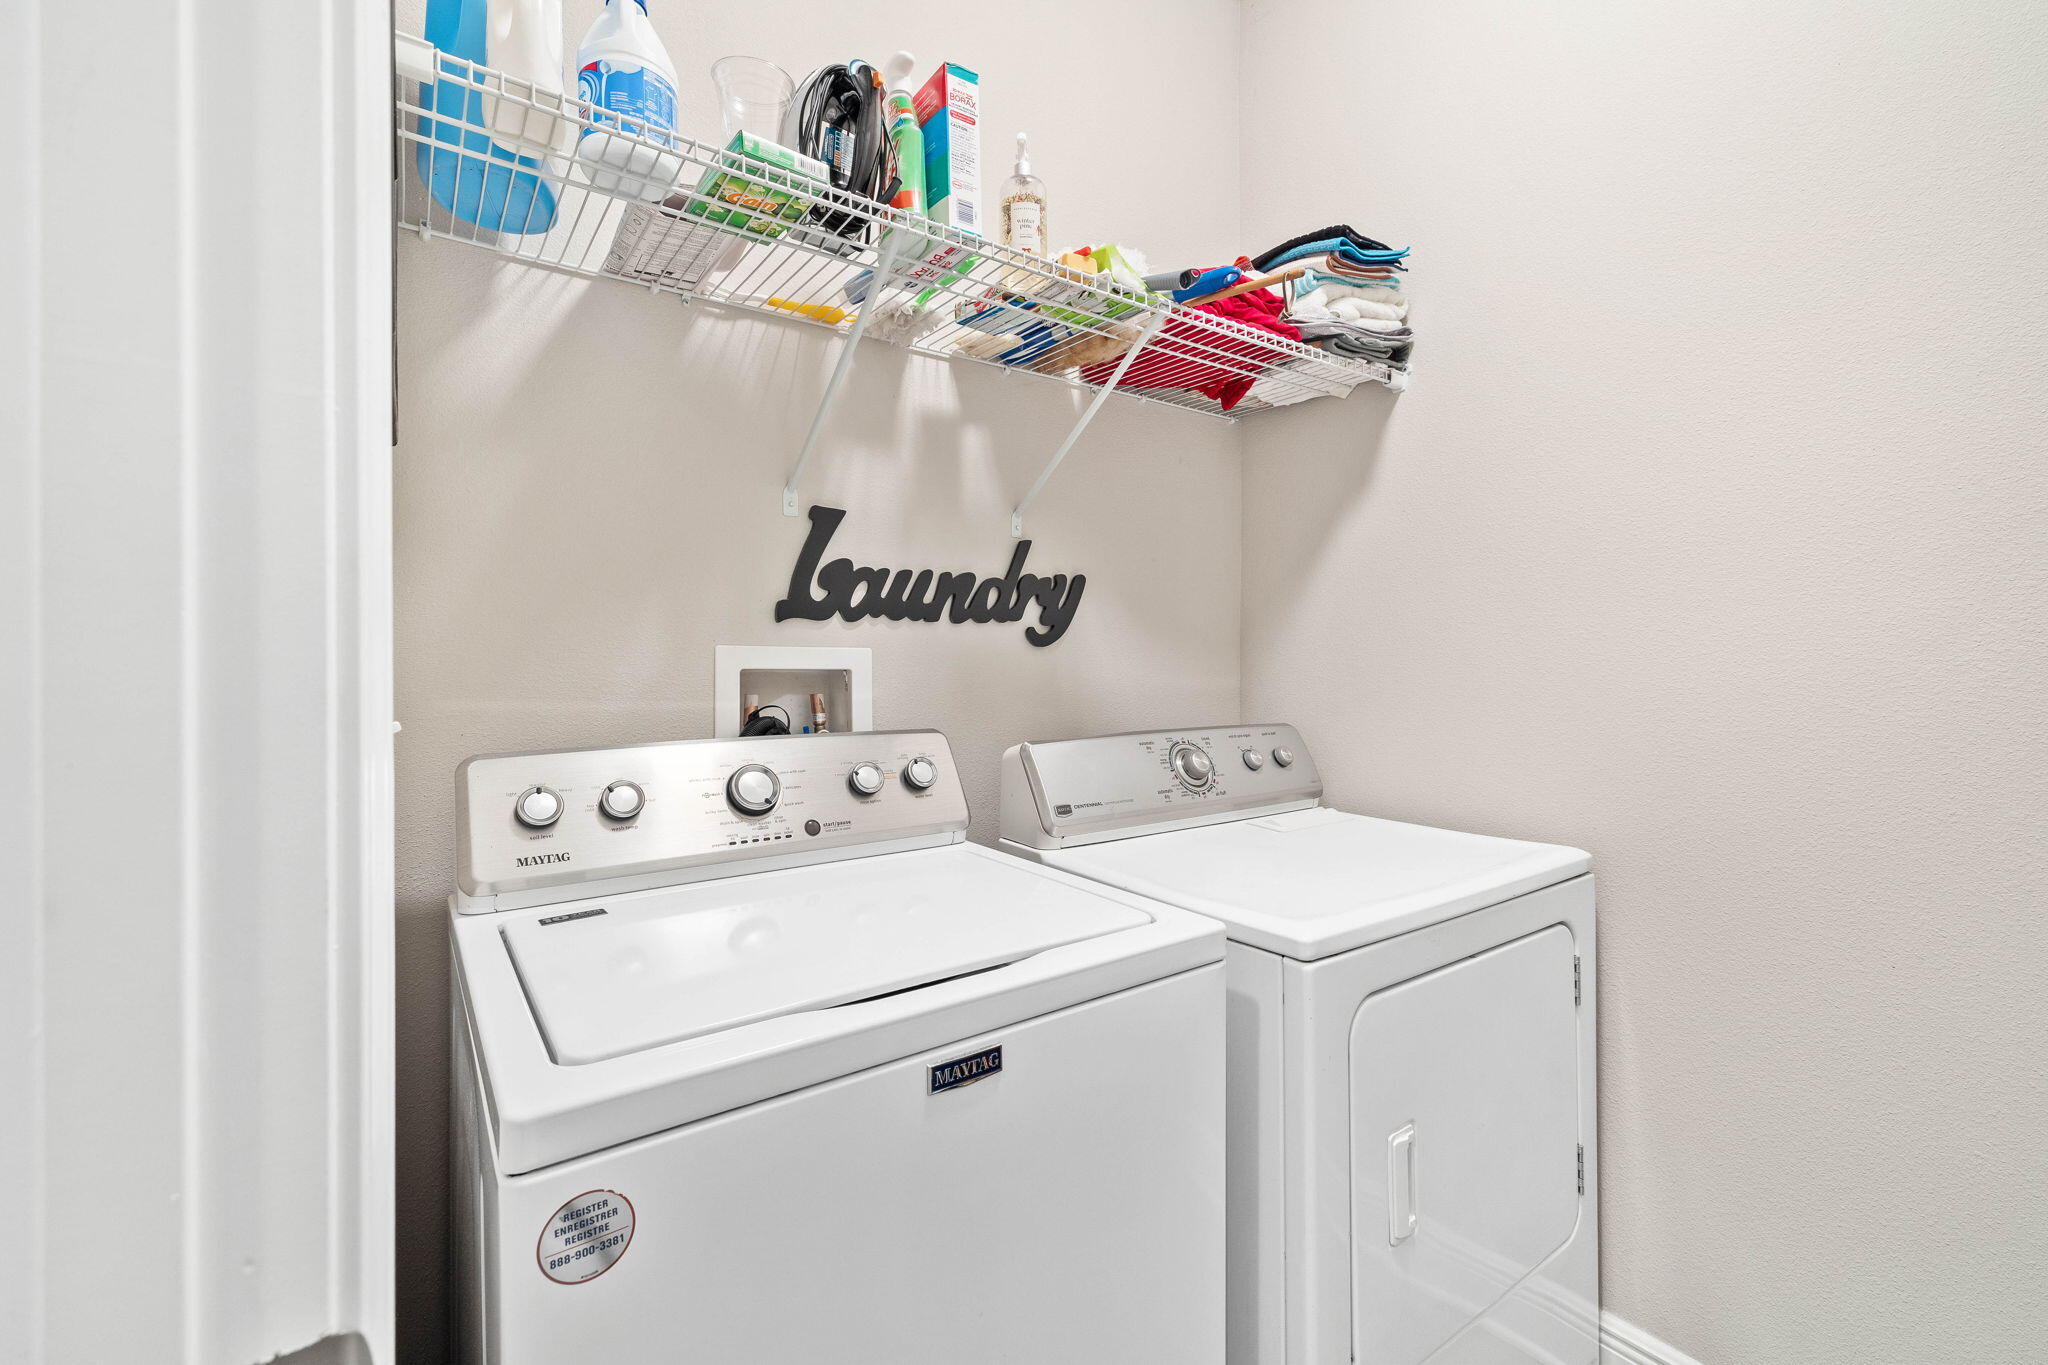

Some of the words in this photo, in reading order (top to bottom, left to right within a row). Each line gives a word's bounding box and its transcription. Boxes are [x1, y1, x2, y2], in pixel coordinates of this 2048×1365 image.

[949, 91, 977, 110] BORAX
[725, 192, 778, 211] Gain
[775, 505, 1087, 648] Laundry
[516, 852, 571, 868] MAYTAG
[934, 1052, 999, 1087] MAYTAG
[553, 1207, 619, 1238] ENREGISTRER
[562, 1199, 609, 1223] REGISTER
[564, 1222, 610, 1247] REGISTRE
[549, 1233, 625, 1270] 888-900-3381
